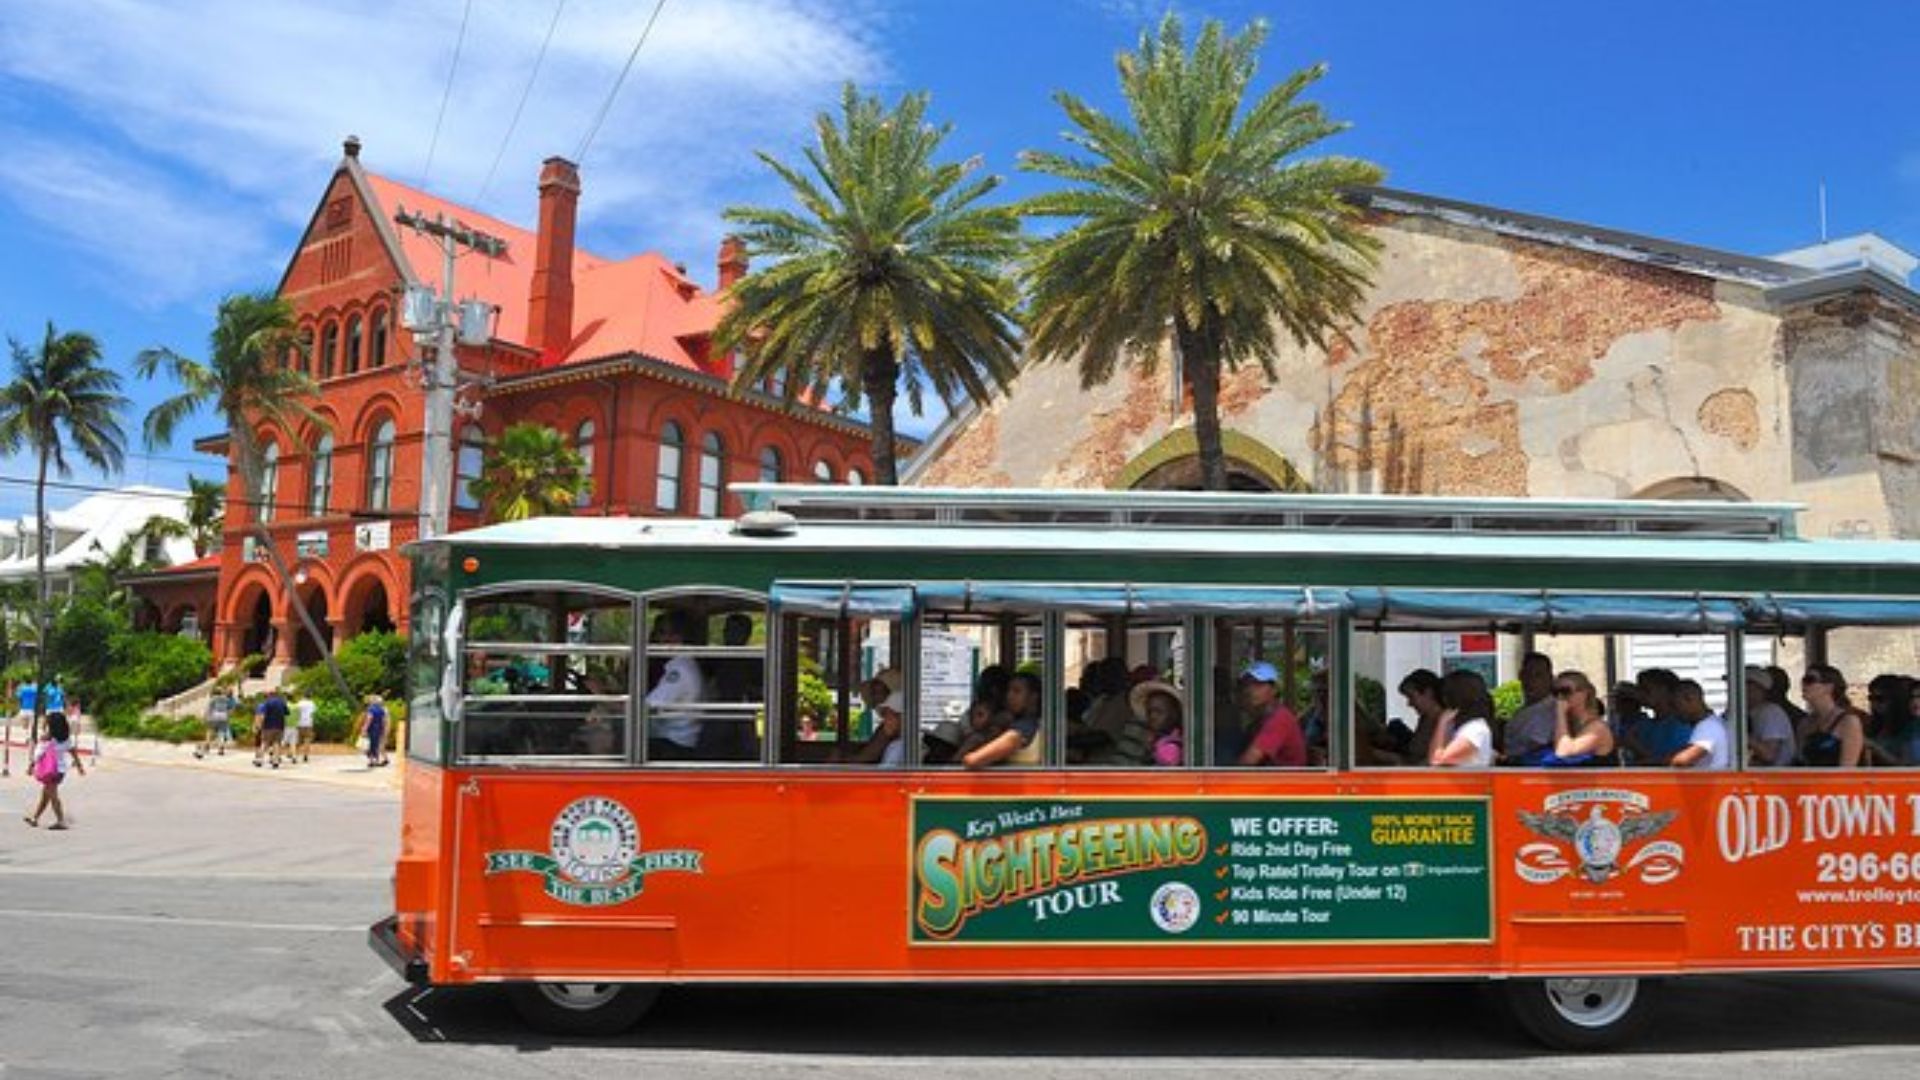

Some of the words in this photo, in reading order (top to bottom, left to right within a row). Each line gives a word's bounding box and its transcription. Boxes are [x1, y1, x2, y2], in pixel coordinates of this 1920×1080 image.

[967, 819, 995, 838] Key
[998, 807, 1046, 828] West's
[1050, 805, 1083, 820] Best
[1230, 817, 1262, 836] WE
[1267, 817, 1339, 836] OFFER:
[1402, 815, 1440, 826] MONEY
[1717, 795, 1791, 863] OLD
[1797, 795, 1896, 843] TOWN
[1371, 827, 1474, 845] GUARANTEE
[645, 851, 693, 868] FIRST
[1231, 842, 1262, 856] Ride
[1265, 842, 1289, 856] 2nd
[1293, 842, 1318, 860] Day
[1322, 842, 1352, 856] Free
[499, 856, 531, 868] SEE
[919, 820, 1205, 935] SIGHTSEEING
[1232, 863, 1257, 882] Top
[1259, 863, 1298, 879] Rated
[1300, 863, 1344, 881] Trolley
[1347, 862, 1378, 877] Tour
[1381, 865, 1400, 877] on
[552, 879, 581, 902] THE
[591, 881, 636, 903] BEST
[1027, 879, 1122, 921] TOUR
[1231, 886, 1263, 900] Kids
[1266, 885, 1298, 900] Ride
[1301, 884, 1333, 900] Free
[1335, 884, 1381, 903] (Under
[1385, 884, 1408, 903] 12)
[1232, 909, 1250, 924] 90
[1253, 908, 1299, 923] Minute
[1300, 907, 1330, 923] Tour
[1736, 926, 1795, 951] THE
[1802, 923, 1885, 949] CITY'S
[1895, 924, 1920, 948] B
